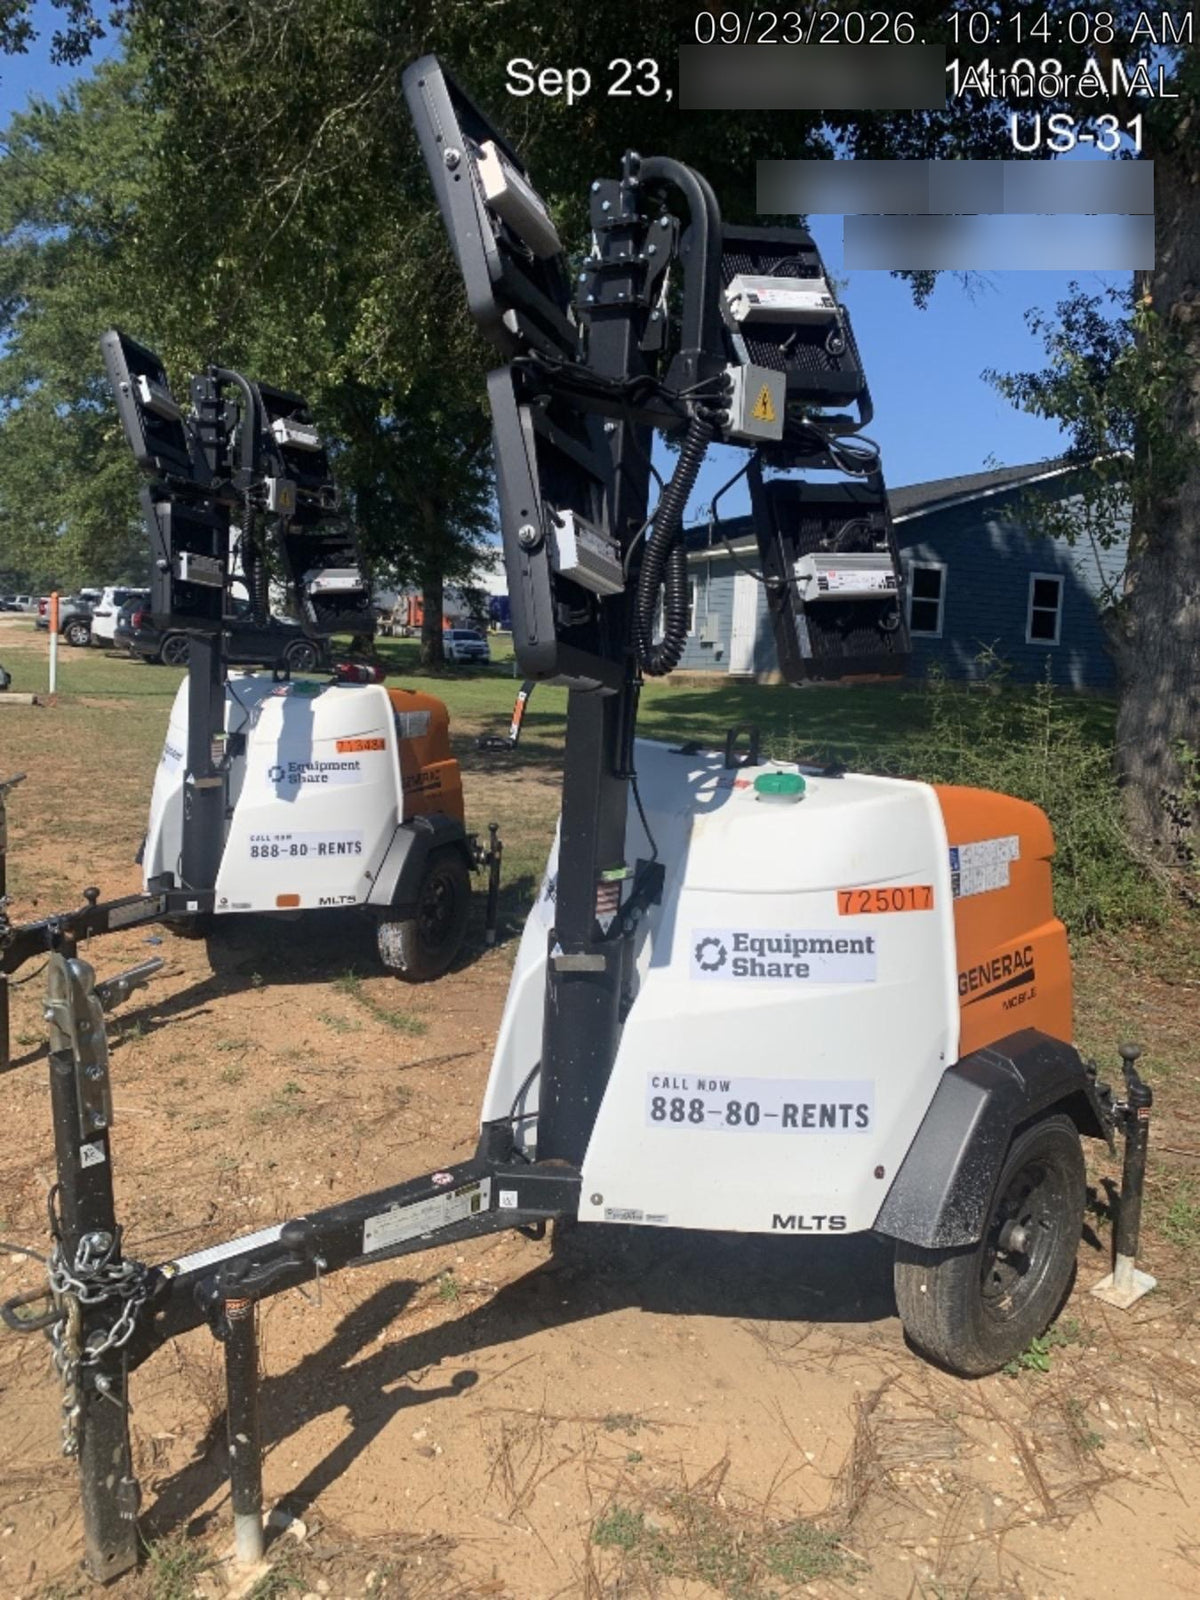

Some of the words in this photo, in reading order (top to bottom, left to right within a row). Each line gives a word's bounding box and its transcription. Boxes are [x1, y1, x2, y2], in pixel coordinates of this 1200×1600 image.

[288, 760, 361, 774] Equipment
[288, 771, 329, 784] Share
[250, 841, 363, 858] 888-80-RENTS
[319, 895, 357, 906] MLTS
[838, 886, 933, 914] 725017
[732, 932, 875, 959] Equipment
[732, 957, 811, 979] Share
[958, 945, 1035, 996] GENERAC
[651, 1076, 690, 1091] CALL
[697, 1078, 732, 1093] NOW
[650, 1096, 870, 1129] 888-80-RENTS
[772, 1213, 848, 1231] MLTS
